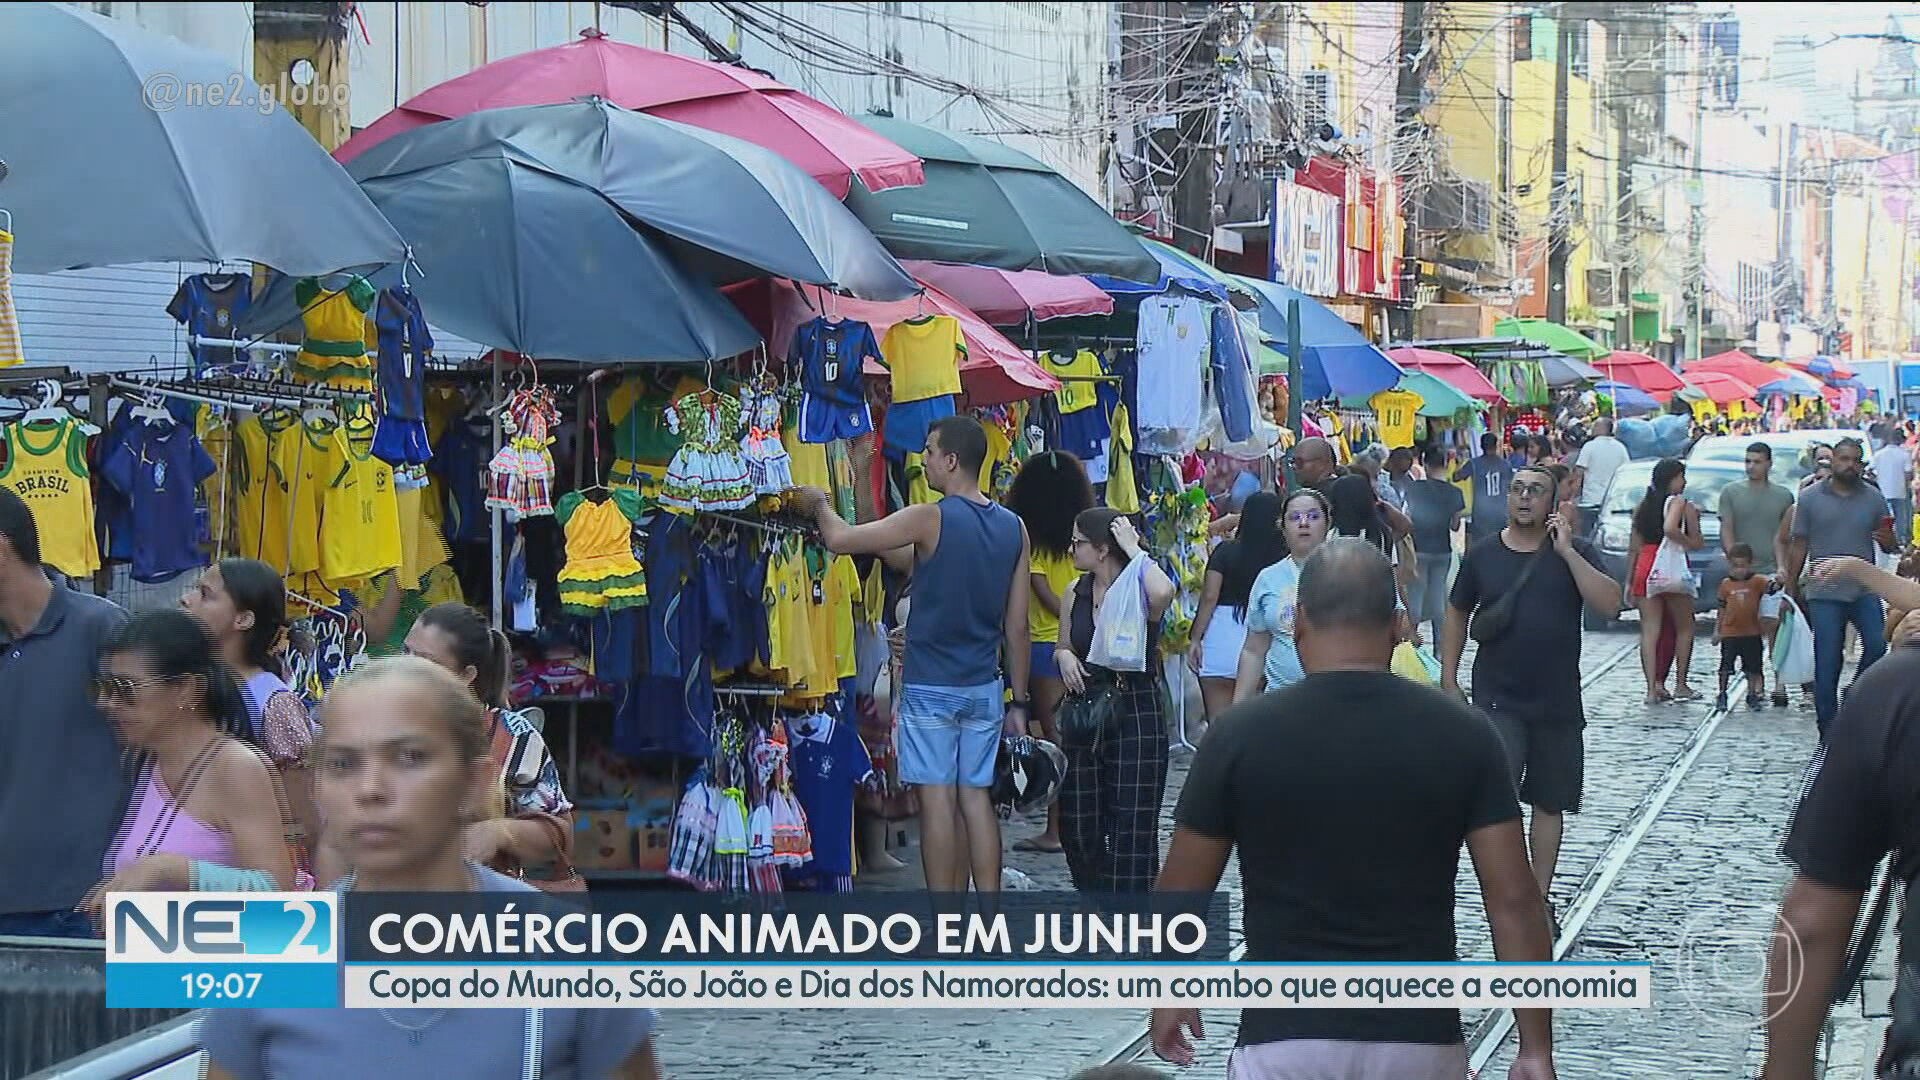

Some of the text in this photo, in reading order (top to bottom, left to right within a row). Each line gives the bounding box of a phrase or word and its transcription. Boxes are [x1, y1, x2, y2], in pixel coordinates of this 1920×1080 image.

[825, 361, 838, 381] 10
[1060, 389, 1074, 406] 10
[1386, 409, 1402, 427] 10
[16, 475, 69, 494] BRASIL
[1485, 471, 1500, 496] 10
